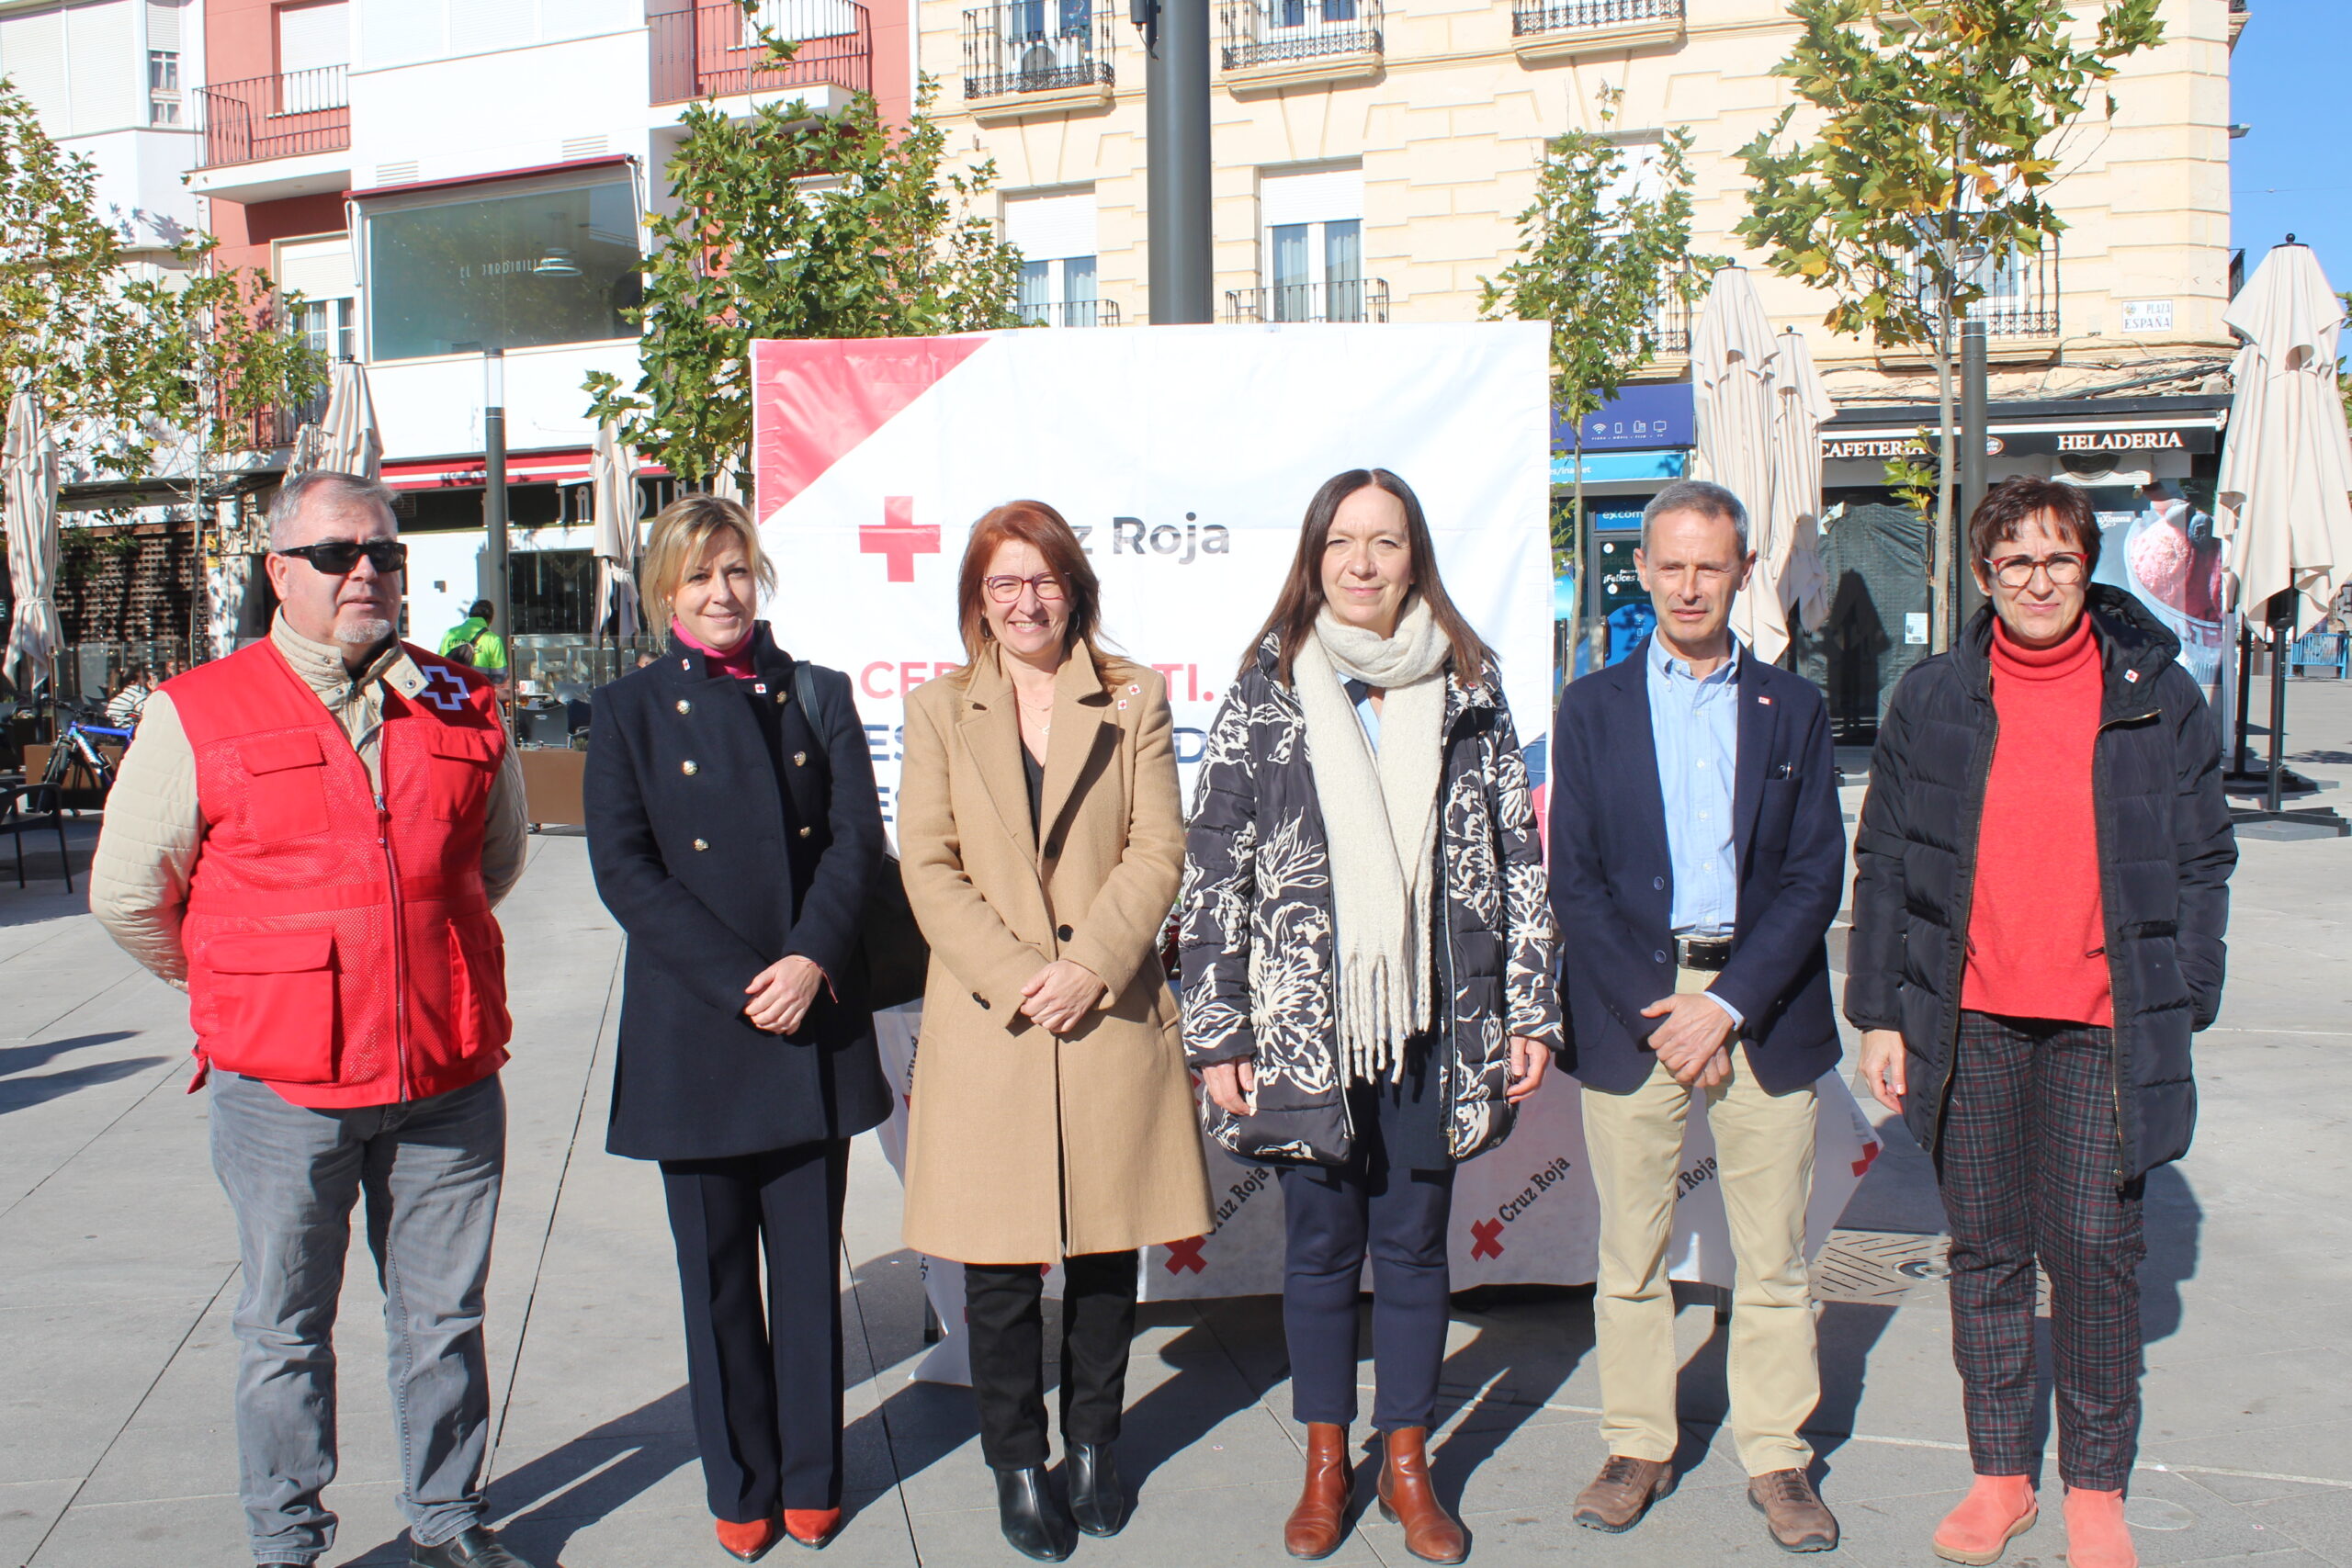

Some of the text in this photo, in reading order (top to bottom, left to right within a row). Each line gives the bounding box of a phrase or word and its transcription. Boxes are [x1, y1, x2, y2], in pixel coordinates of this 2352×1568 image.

[2124, 316, 2170, 330] ESPAÑA
[2146, 303, 2170, 314] PLAZA
[2057, 431, 2184, 451] HELADERIA
[1113, 512, 1230, 565] Roja
[1229, 1166, 1270, 1203] Roja
[1498, 1156, 1571, 1223] Cruz Roja
[1679, 1156, 1717, 1190] Roja
